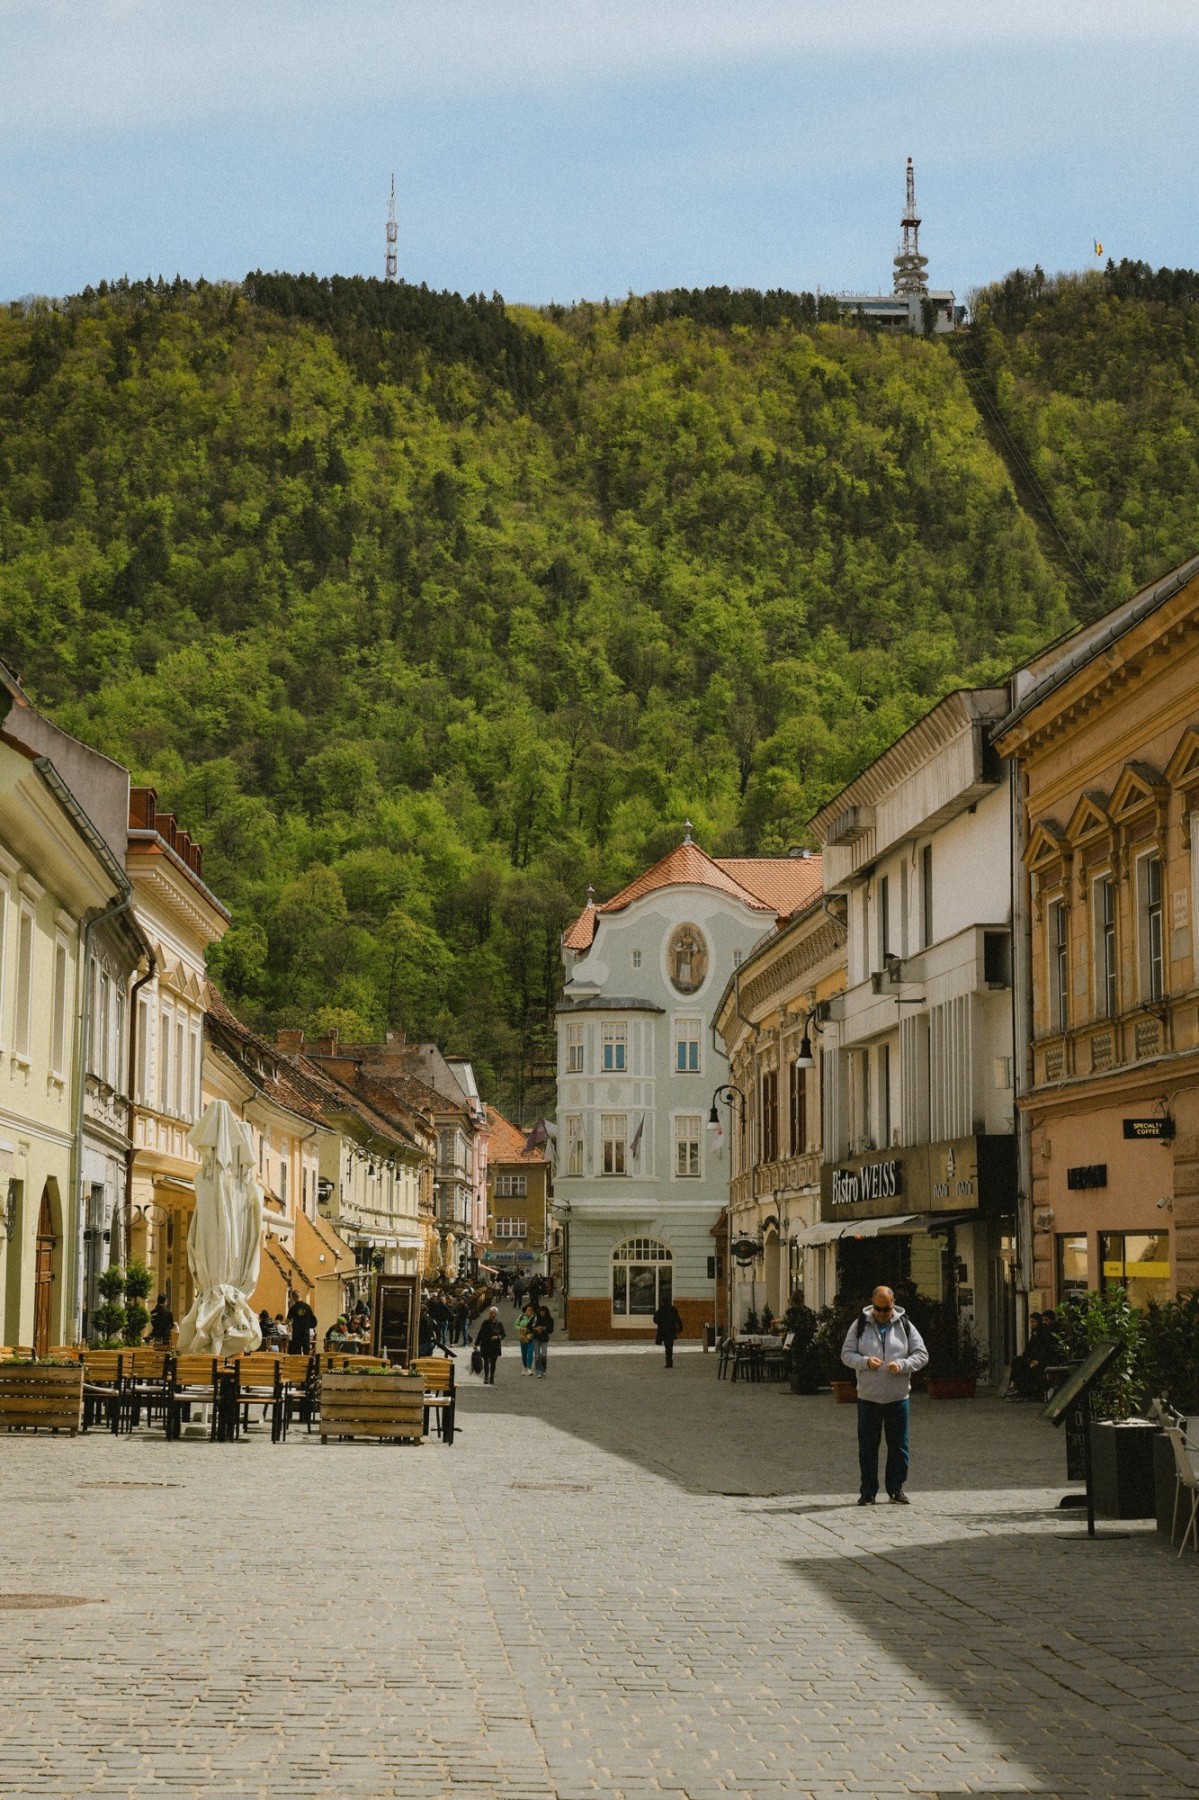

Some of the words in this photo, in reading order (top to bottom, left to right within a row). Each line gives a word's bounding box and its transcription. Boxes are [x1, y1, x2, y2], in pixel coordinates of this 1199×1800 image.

[1133, 1122, 1162, 1130] SPECIALTY
[832, 1169, 859, 1204] Bistro
[860, 1160, 896, 1200] WEISS
